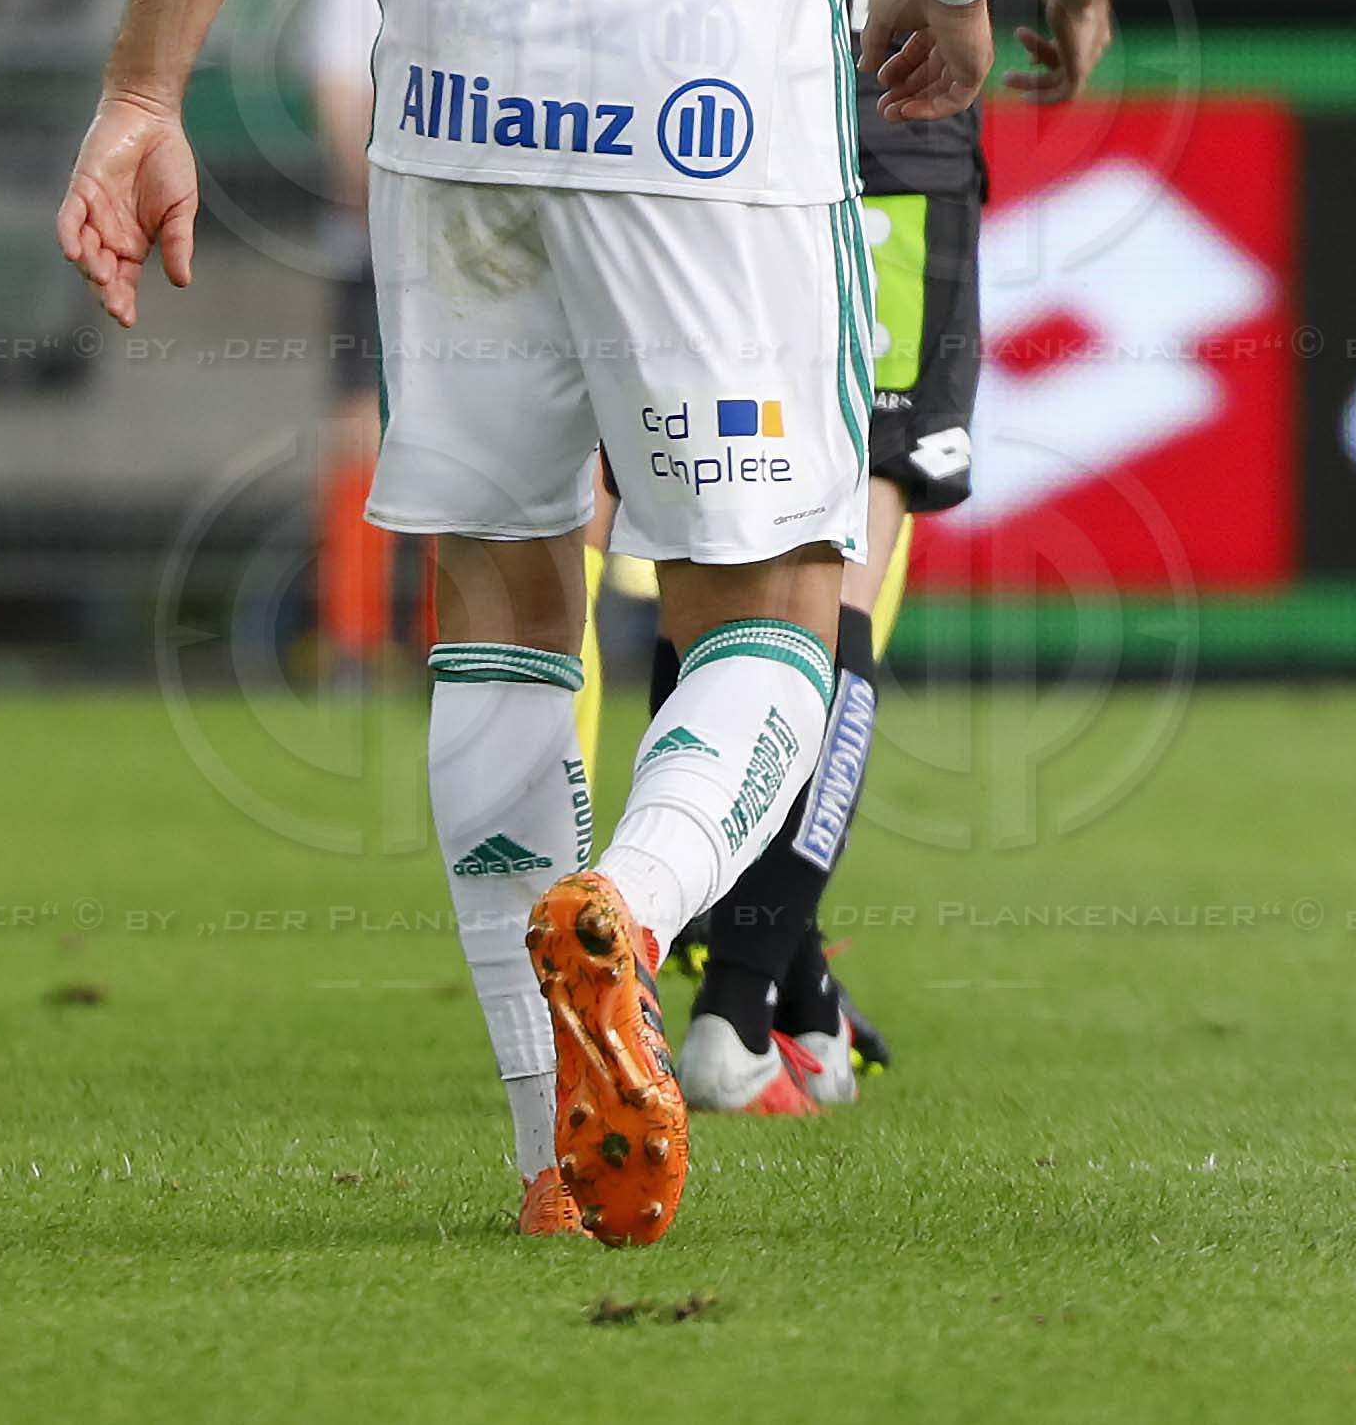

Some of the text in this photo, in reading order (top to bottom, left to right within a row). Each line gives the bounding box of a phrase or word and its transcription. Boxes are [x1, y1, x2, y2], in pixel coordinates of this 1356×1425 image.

[399, 64, 634, 156] Allianz
[810, 680, 875, 857] UNTIGAMER
[453, 854, 553, 877] adidas
